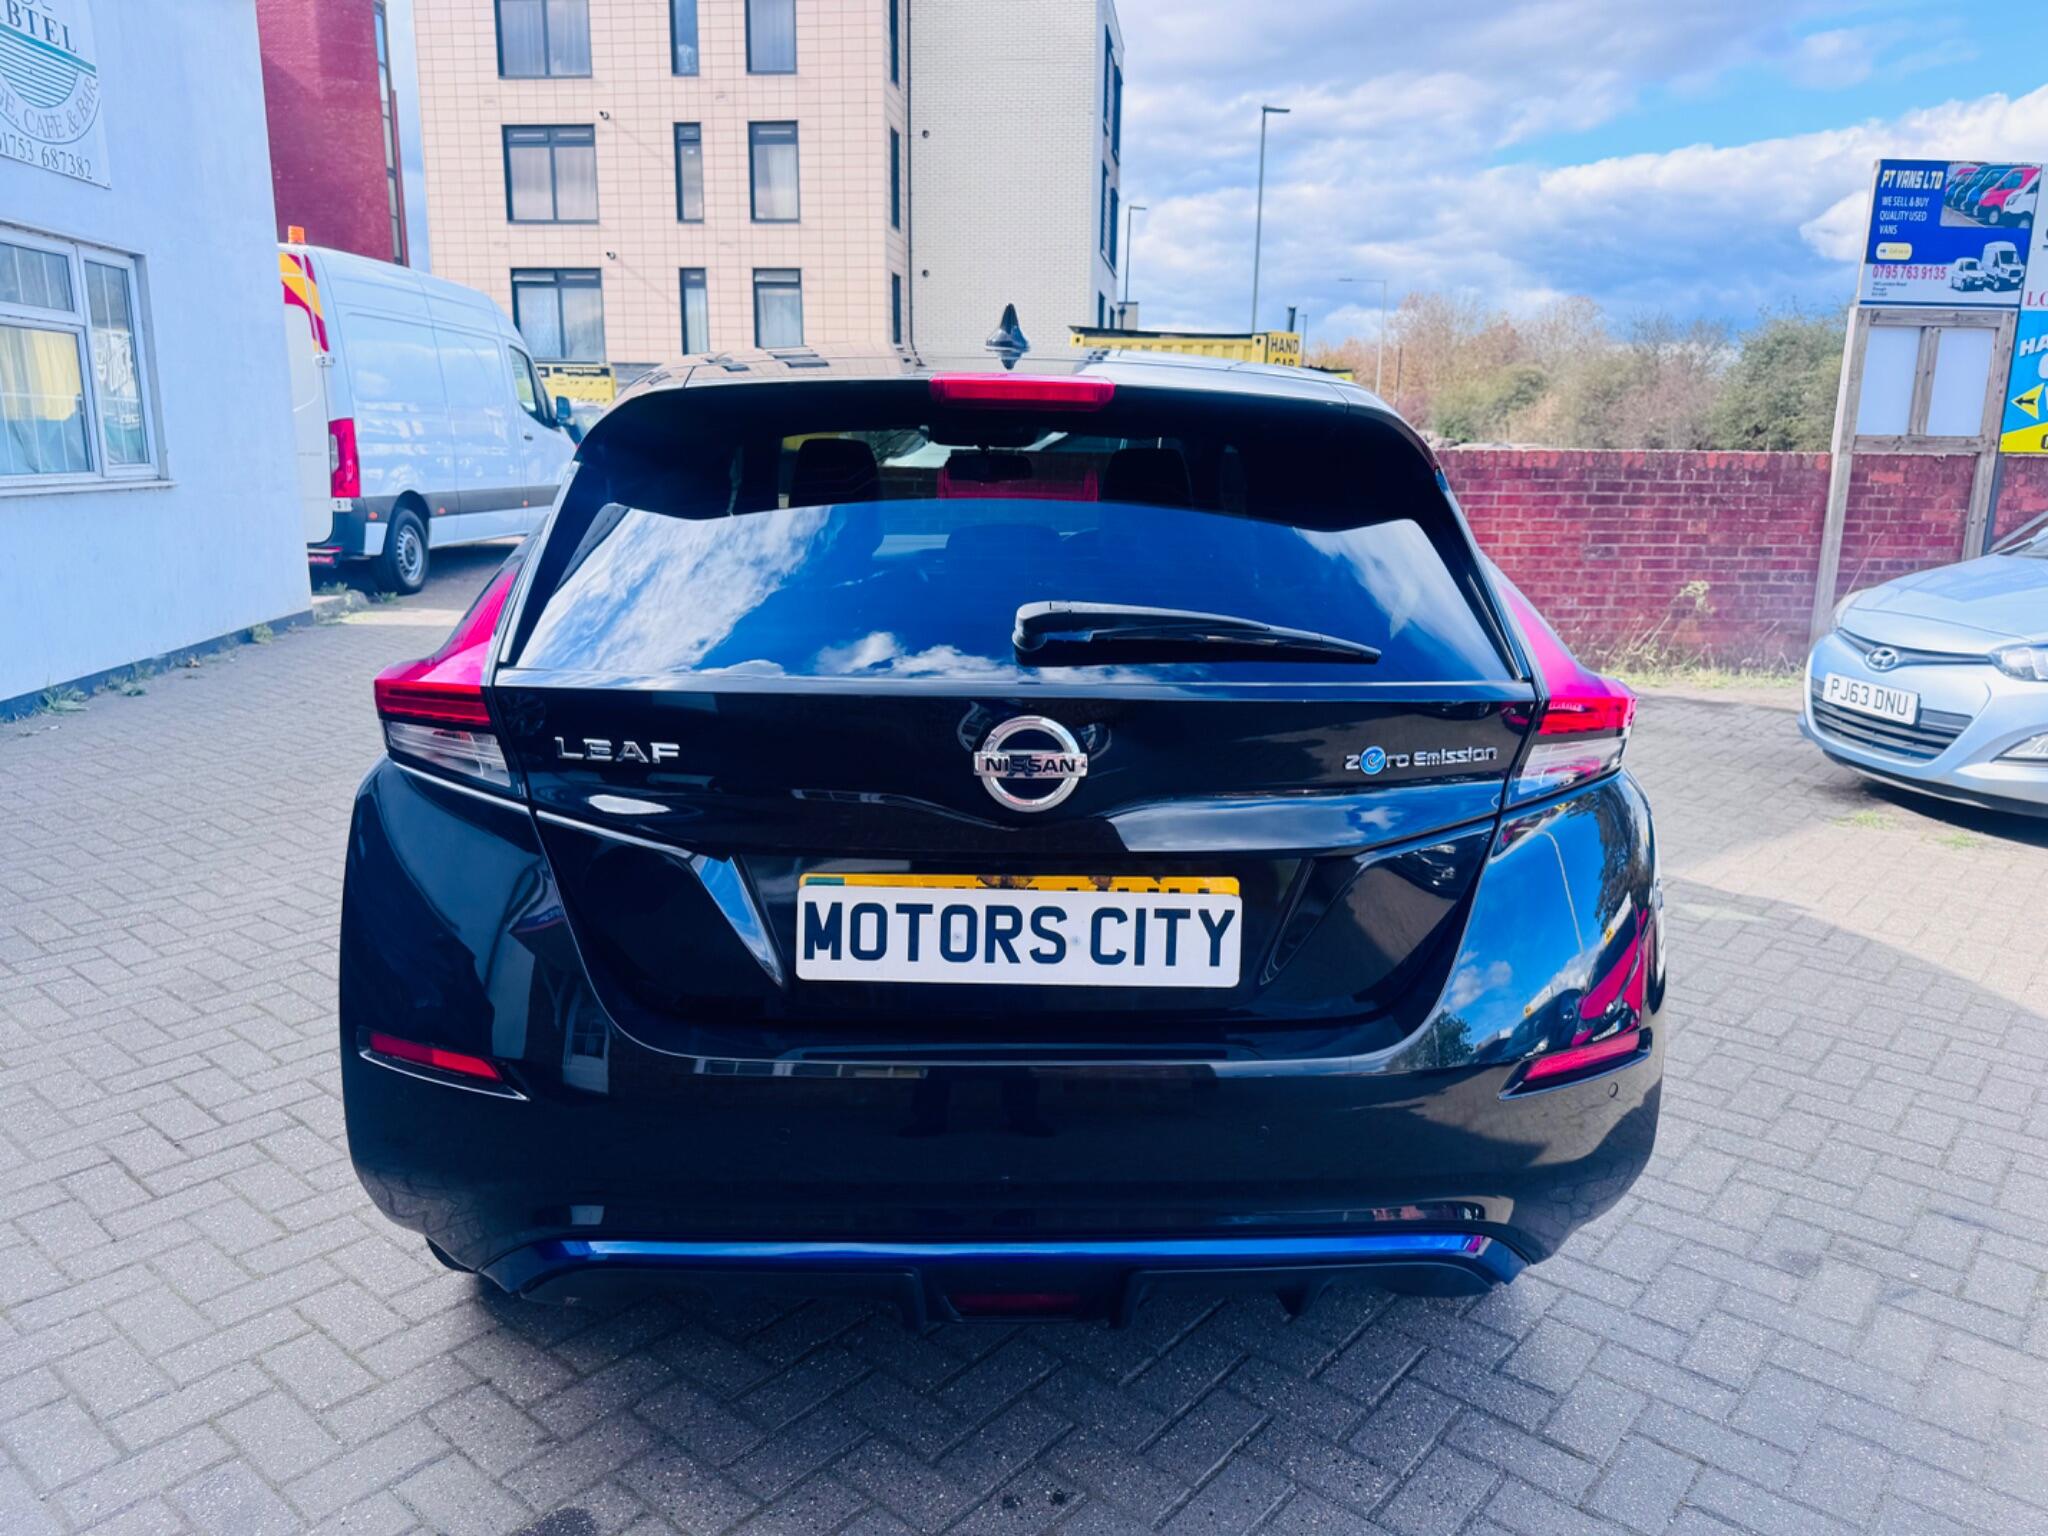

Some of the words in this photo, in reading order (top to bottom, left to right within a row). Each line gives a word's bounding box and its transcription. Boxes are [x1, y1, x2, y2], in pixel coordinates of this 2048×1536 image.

[0, 0, 77, 53] BTEL
[24, 108, 66, 138] CAFE
[67, 109, 80, 134] &
[0, 132, 34, 161] 1753
[41, 146, 92, 180] 687382
[1880, 169, 1897, 189] PT
[1896, 170, 1924, 189] VANS
[1923, 170, 1945, 190] LTD
[1915, 196, 1930, 208] BUY
[1880, 210, 1909, 221] QUALITY
[1909, 211, 1927, 222] USED
[1880, 224, 1898, 235] VANS
[1872, 264, 1898, 279] 0795
[1900, 266, 1919, 280] 763
[1921, 266, 1947, 280] 9135
[1270, 336, 1299, 354] HAND
[1829, 678, 1870, 706] PJ63
[1874, 689, 1909, 716] DNU
[555, 736, 680, 764] LEAF
[1413, 746, 1497, 767] Emission
[985, 757, 1076, 773] NISSAN
[803, 901, 1068, 965] MOTORS
[1090, 906, 1236, 968] CITY
